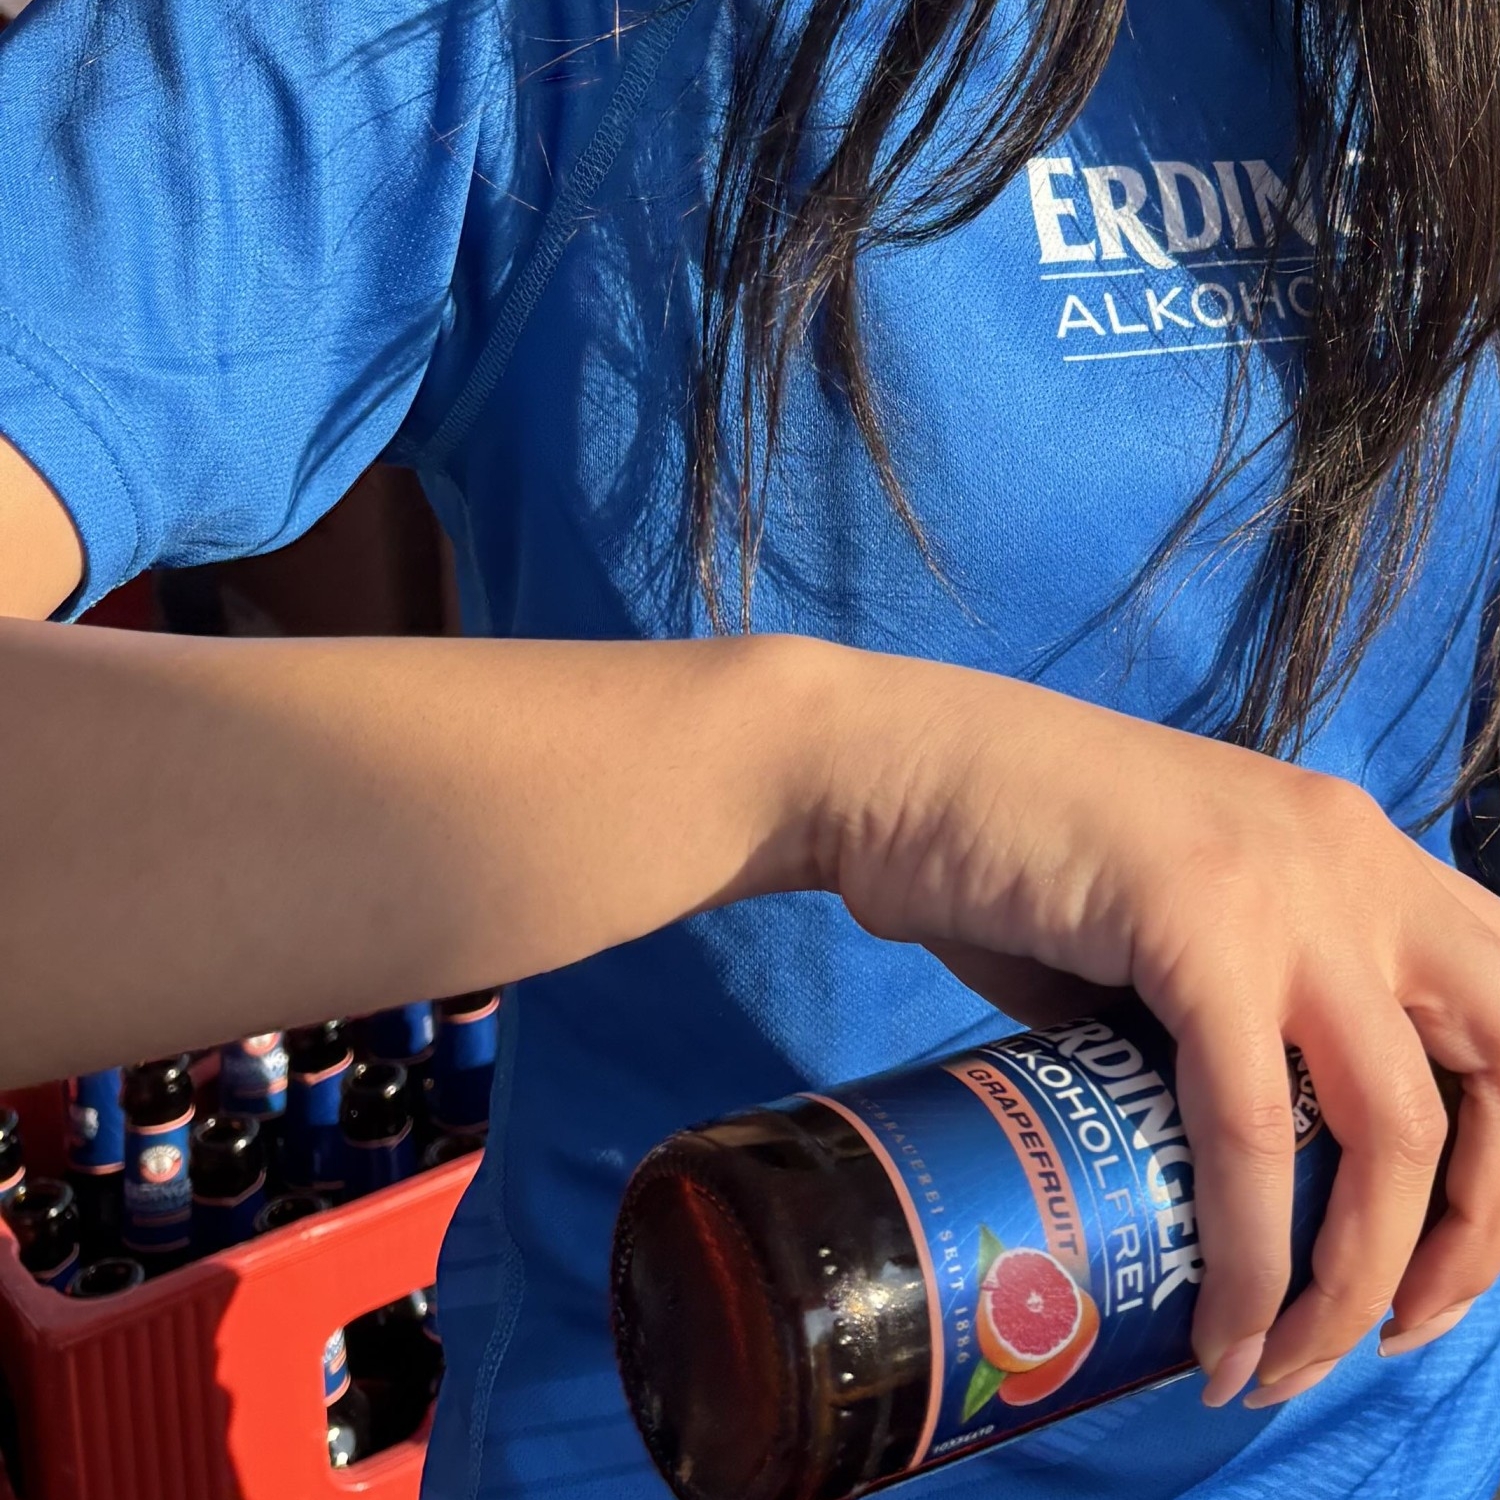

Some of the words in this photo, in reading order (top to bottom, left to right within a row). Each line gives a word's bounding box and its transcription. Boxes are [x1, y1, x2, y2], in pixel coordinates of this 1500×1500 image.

[1028, 157, 1319, 270] ERDIN
[1056, 275, 1316, 339] ALKOHO
[966, 1067, 1079, 1257] GRAPEFRUIT
[938, 1229, 966, 1292] SEIT
[953, 1306, 971, 1364] 1886
